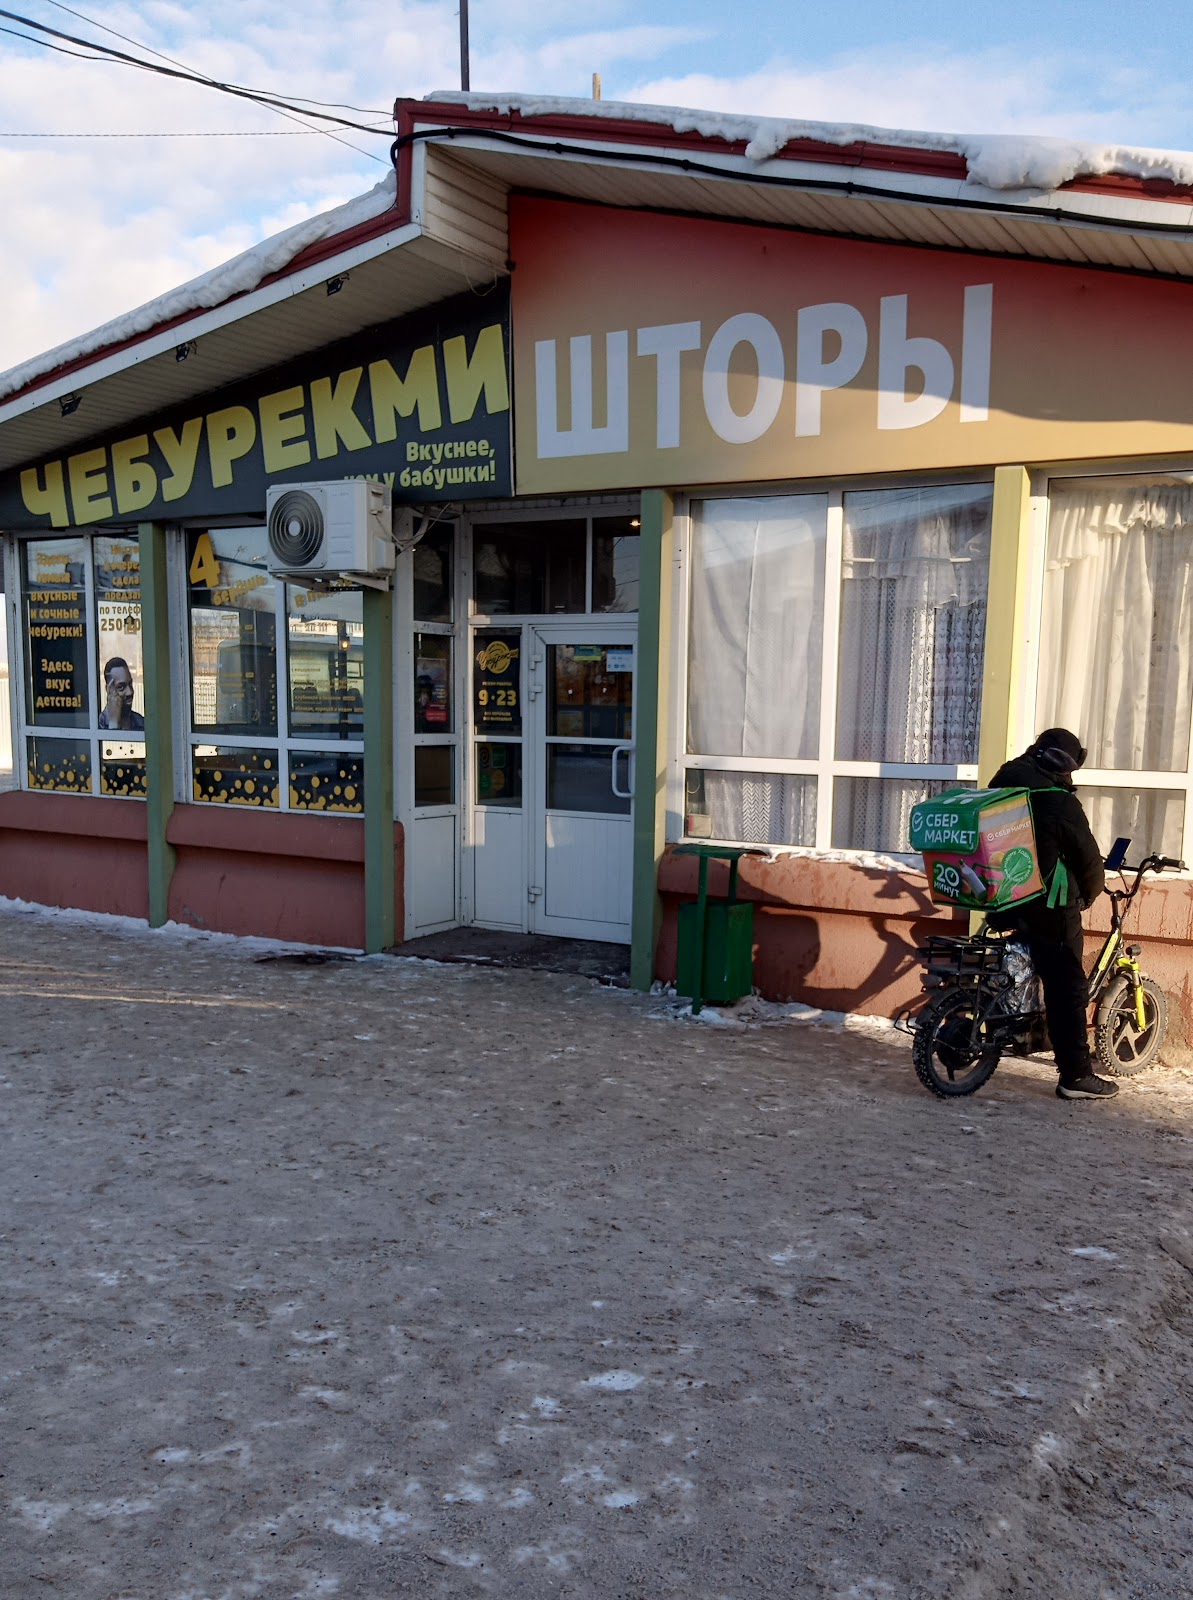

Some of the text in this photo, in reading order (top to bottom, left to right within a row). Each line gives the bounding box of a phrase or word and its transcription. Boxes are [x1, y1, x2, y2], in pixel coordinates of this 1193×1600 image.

[535, 283, 993, 459] ШТОРЫ
[19, 323, 510, 528] ЧЕБУРЕКМИ
[406, 439, 495, 465] Вкуснее,
[400, 460, 496, 490] бабушки!
[190, 533, 221, 588] 4
[31, 591, 78, 604] вкусные
[30, 608, 79, 619] и сочные
[99, 606, 110, 615] по
[28, 624, 83, 640] чебуреки!
[41, 658, 74, 673] Здесь
[45, 678, 71, 692] вкус
[36, 694, 82, 708] детства!
[926, 813, 958, 828] СБЕР
[924, 829, 976, 844] МАРКЕТ
[994, 828, 1010, 838] СБЕР
[936, 863, 960, 887] 20
